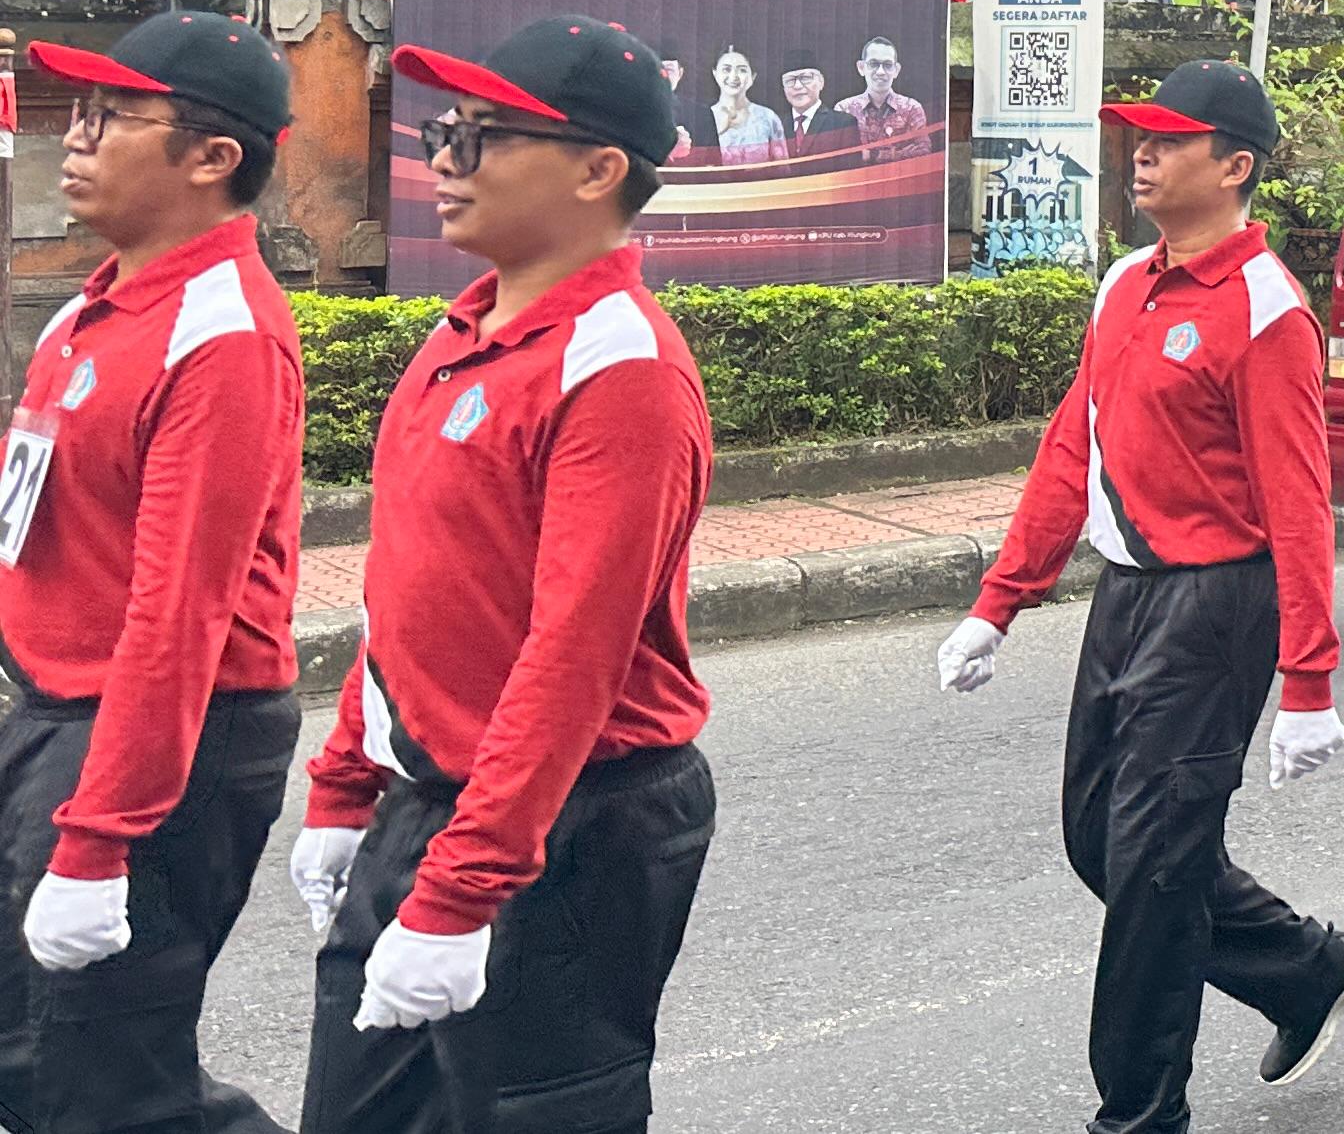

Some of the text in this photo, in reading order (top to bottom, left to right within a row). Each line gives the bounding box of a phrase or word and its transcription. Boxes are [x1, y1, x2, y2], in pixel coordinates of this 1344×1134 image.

[992, 11, 1087, 21] SEGERA DAFTAR
[1028, 157, 1037, 175] 1
[1017, 176, 1051, 185] RUMAH
